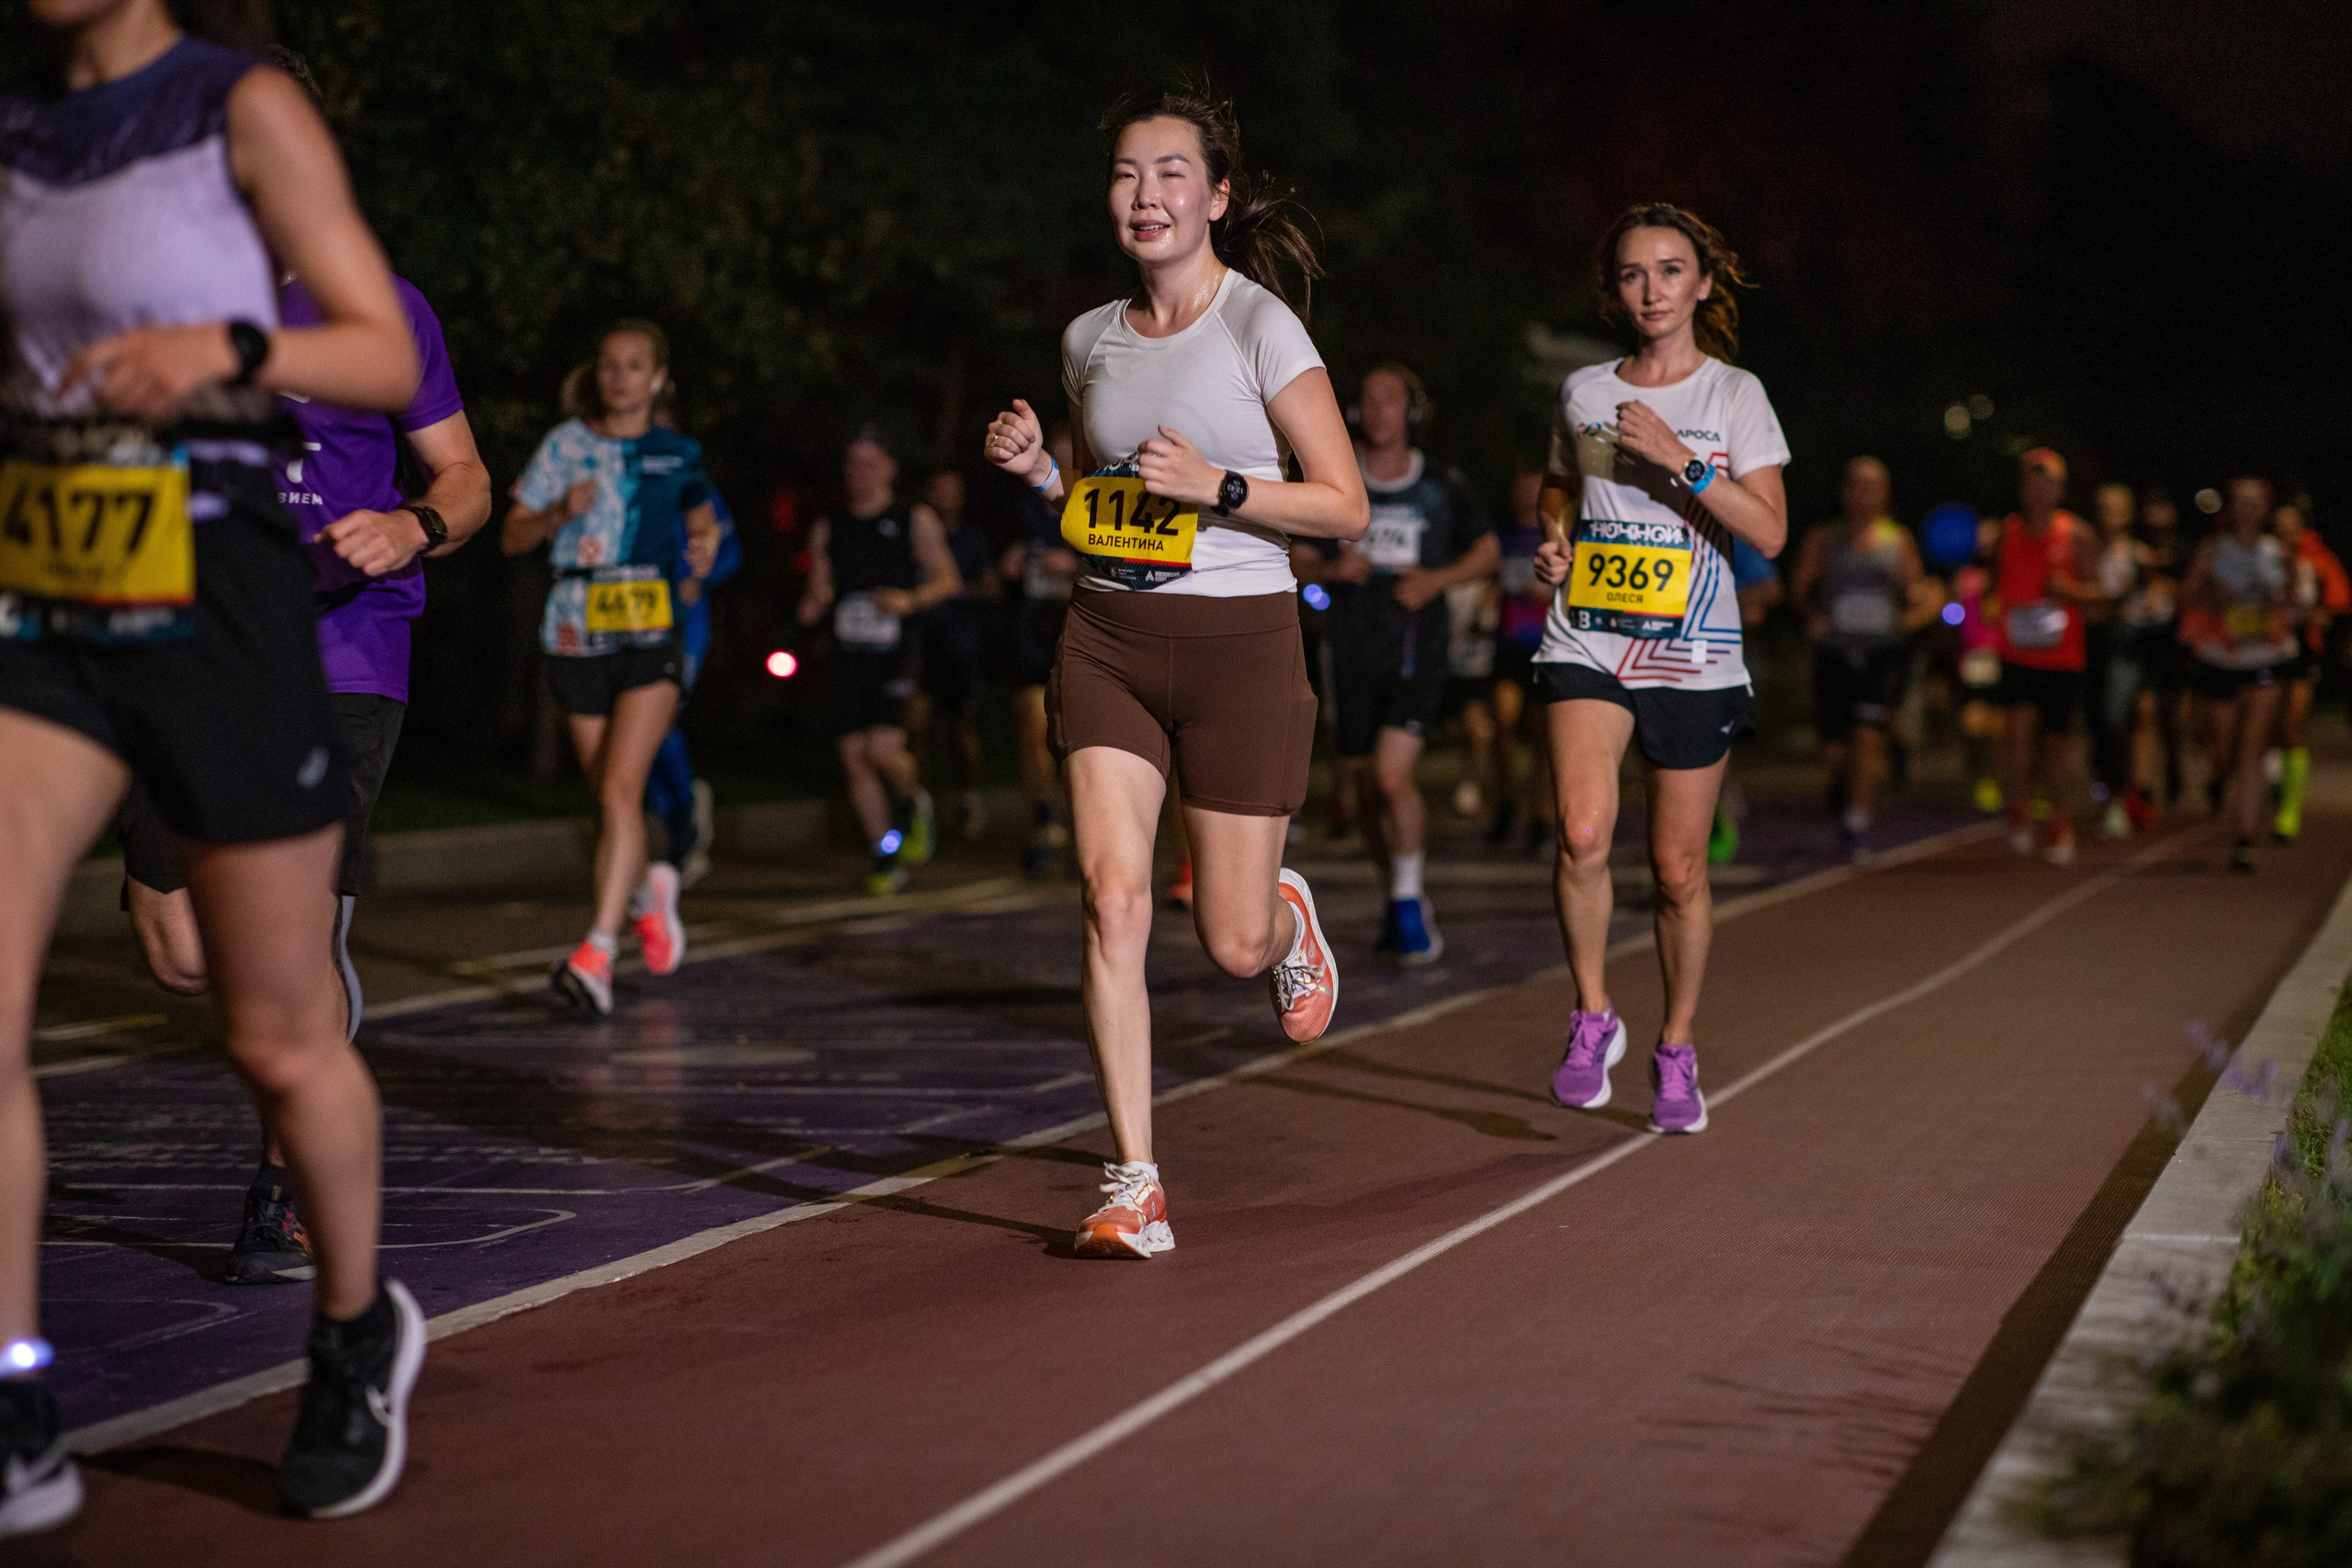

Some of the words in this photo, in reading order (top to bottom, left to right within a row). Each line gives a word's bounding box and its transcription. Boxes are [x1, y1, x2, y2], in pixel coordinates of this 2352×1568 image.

[1084, 488, 1180, 536] 1142
[1088, 534, 1164, 552] ВАЛЕНТИНА
[1589, 553, 1674, 592] 9369
[1606, 592, 1644, 604] ОЛЕСЯ
